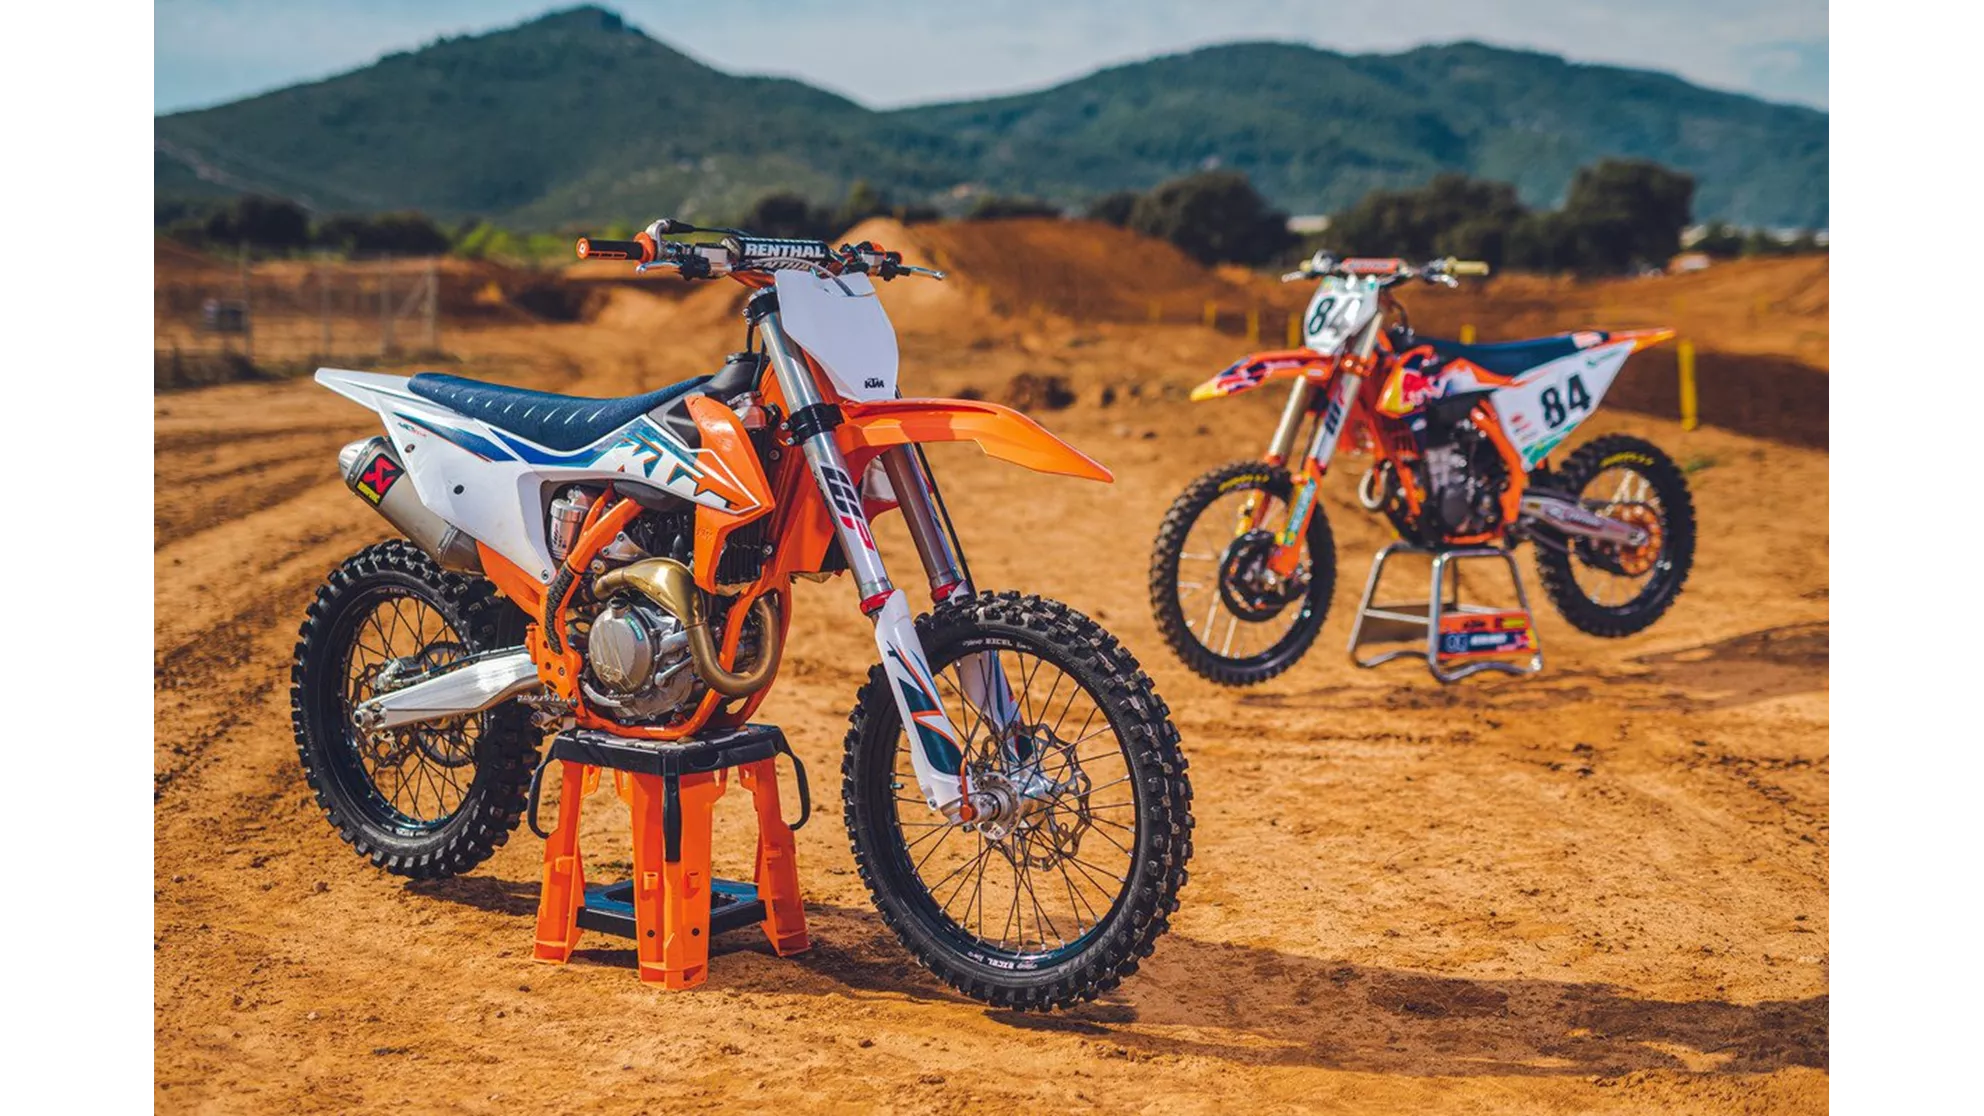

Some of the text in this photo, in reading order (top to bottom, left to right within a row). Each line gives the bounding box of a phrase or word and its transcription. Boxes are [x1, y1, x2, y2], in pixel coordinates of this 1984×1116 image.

[744, 243, 825, 258] RENTHAL
[864, 377, 885, 389] KTM
[1540, 374, 1591, 429] 84
